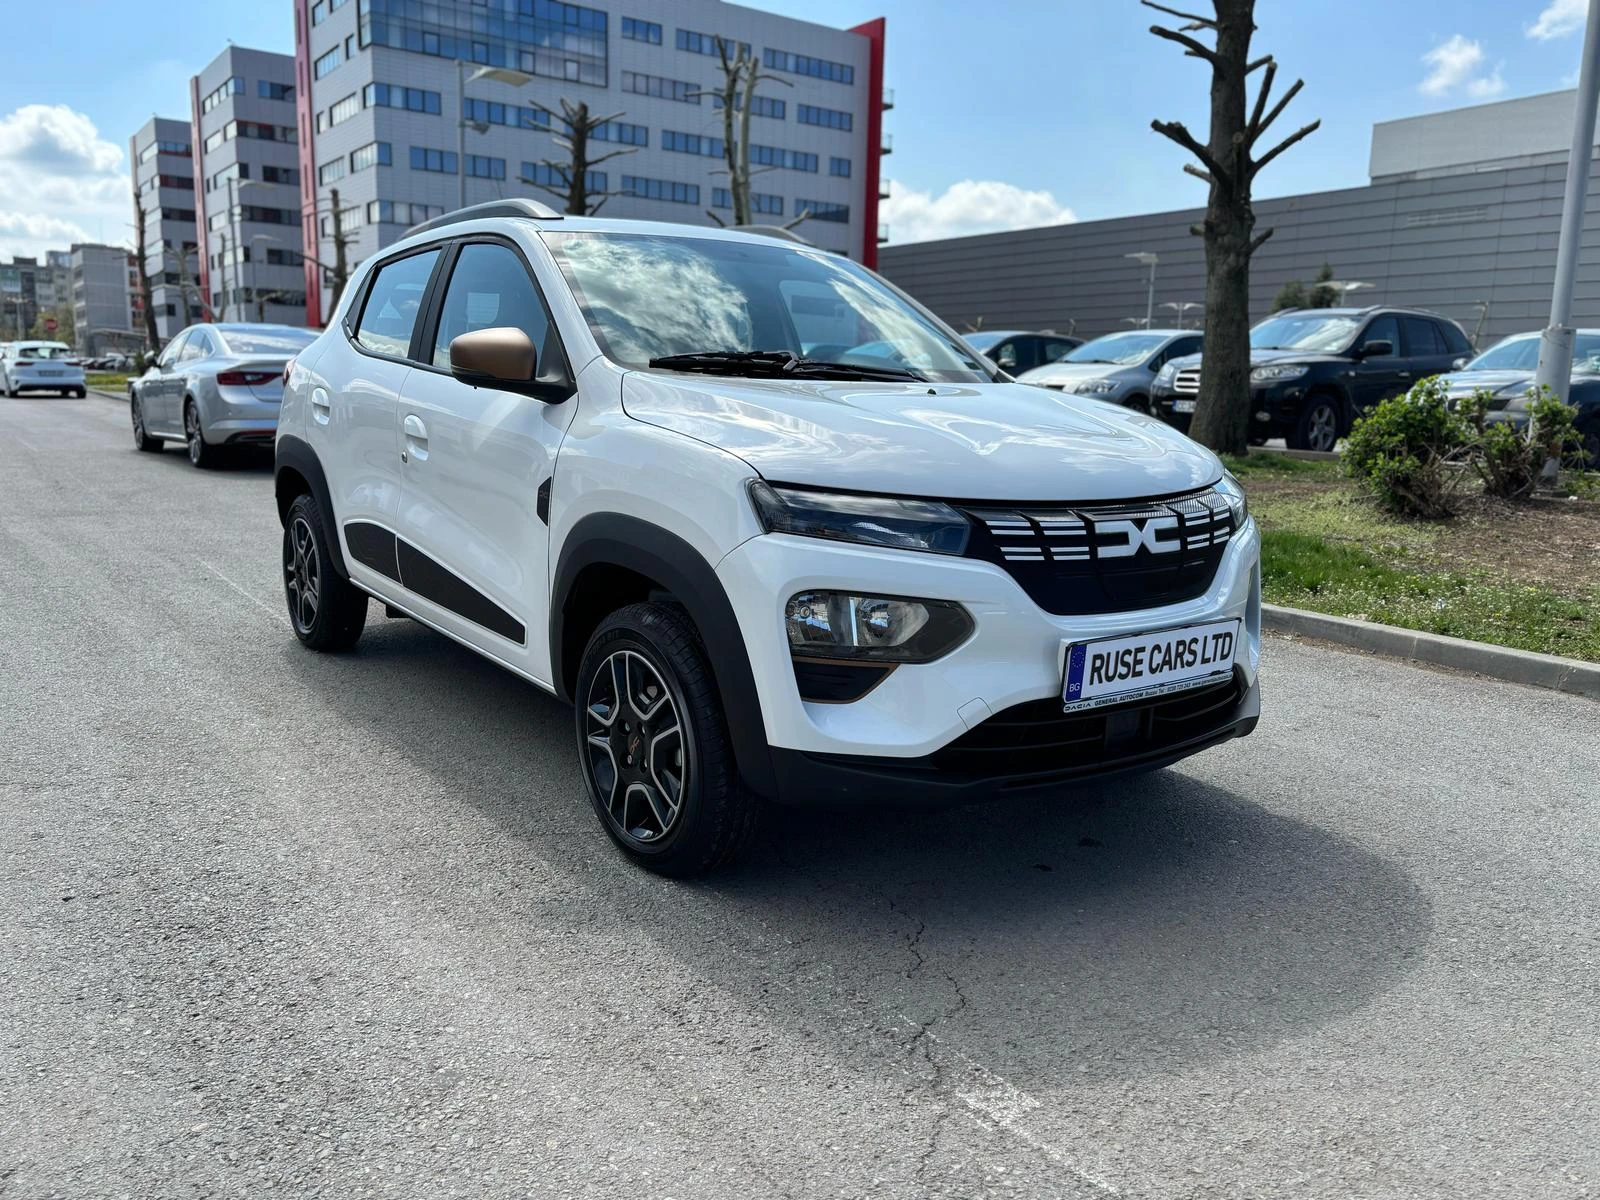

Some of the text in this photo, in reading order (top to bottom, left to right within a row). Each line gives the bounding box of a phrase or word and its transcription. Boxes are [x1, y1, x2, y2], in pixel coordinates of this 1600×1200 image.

[1089, 632, 1233, 685] RUSE CARS LTD
[1069, 683, 1080, 692] BG
